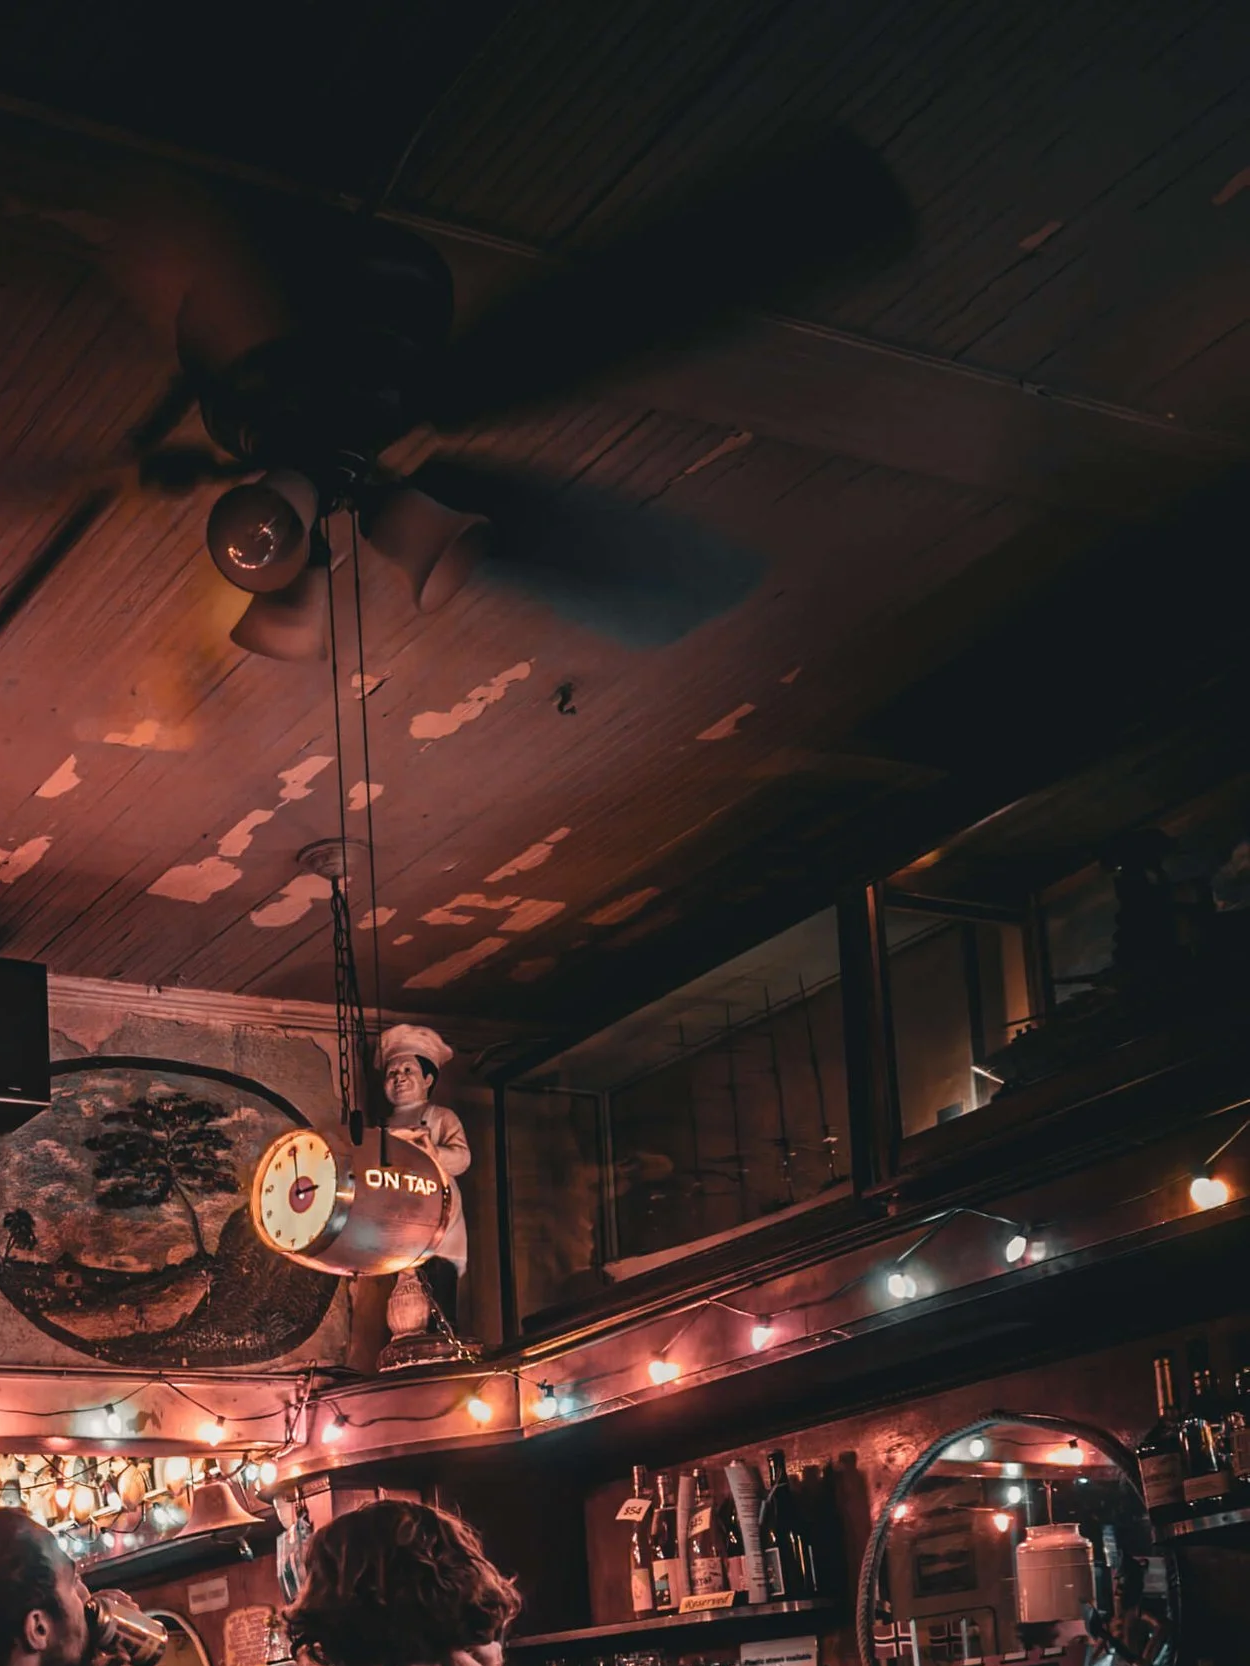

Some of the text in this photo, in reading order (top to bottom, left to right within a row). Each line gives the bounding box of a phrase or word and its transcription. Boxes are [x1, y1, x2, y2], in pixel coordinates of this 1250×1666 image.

[365, 1168, 438, 1196] ON TAP
[684, 1593, 733, 1610] Reserved
